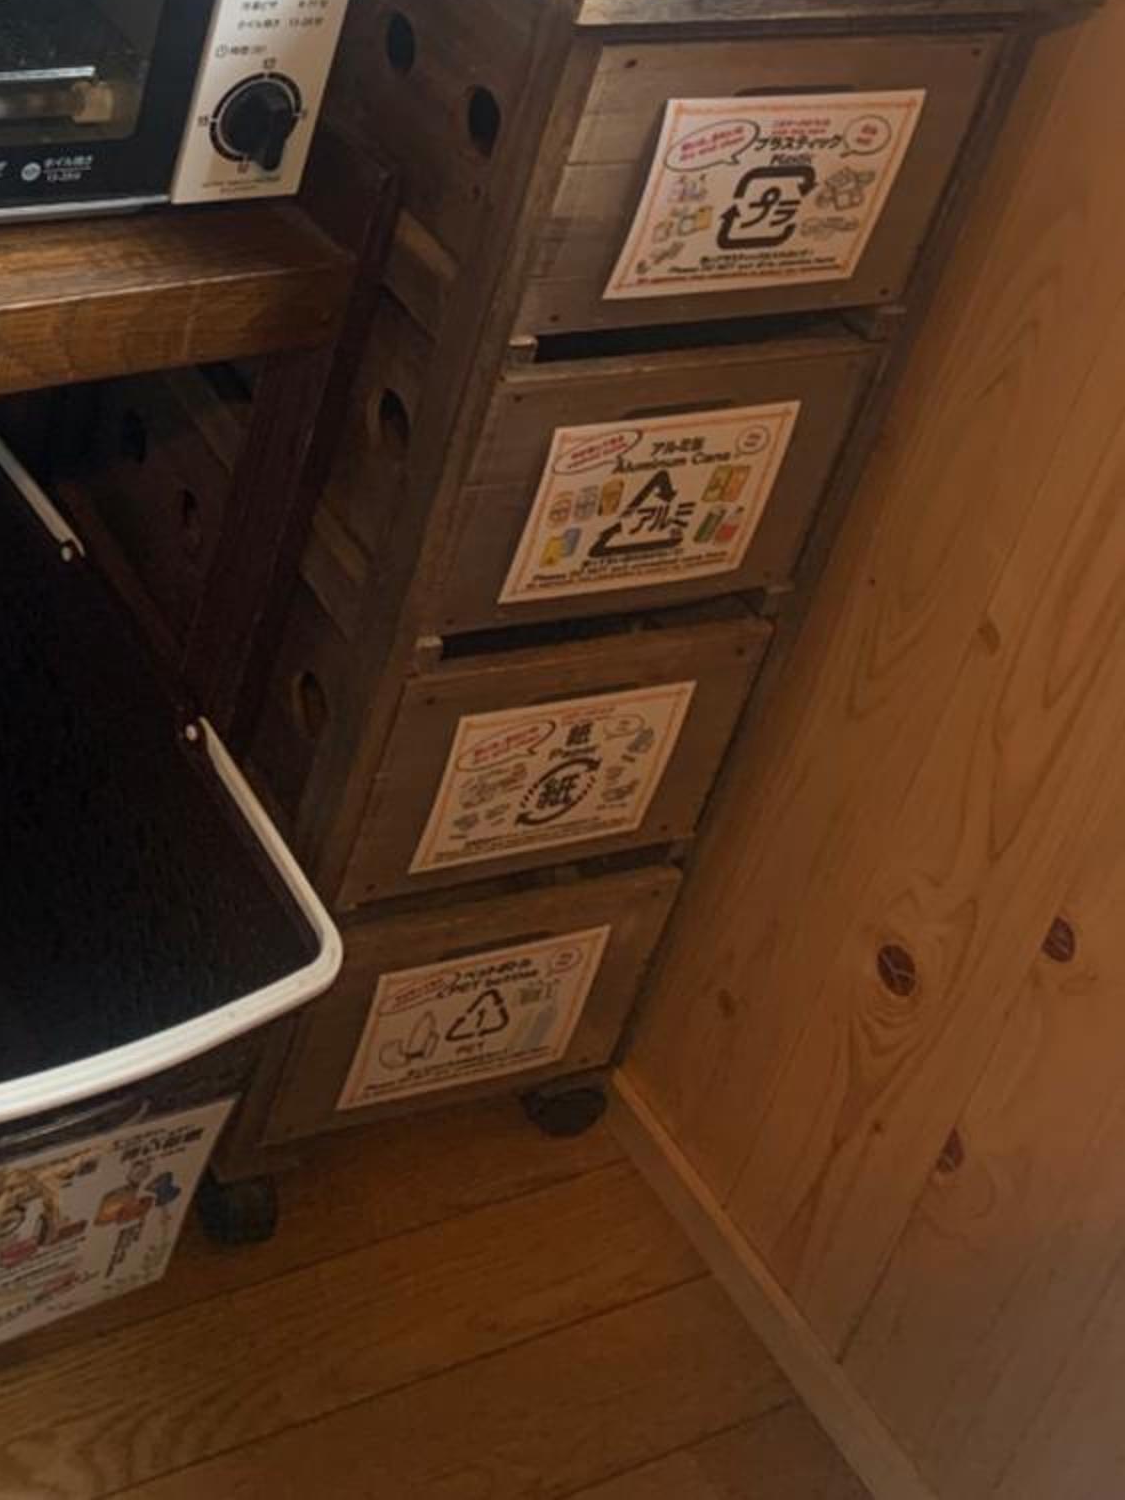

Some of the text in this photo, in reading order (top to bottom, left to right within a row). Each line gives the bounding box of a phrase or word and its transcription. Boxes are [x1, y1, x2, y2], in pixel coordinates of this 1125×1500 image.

[740, 186, 801, 228] プラ
[628, 501, 697, 536] アルミ
